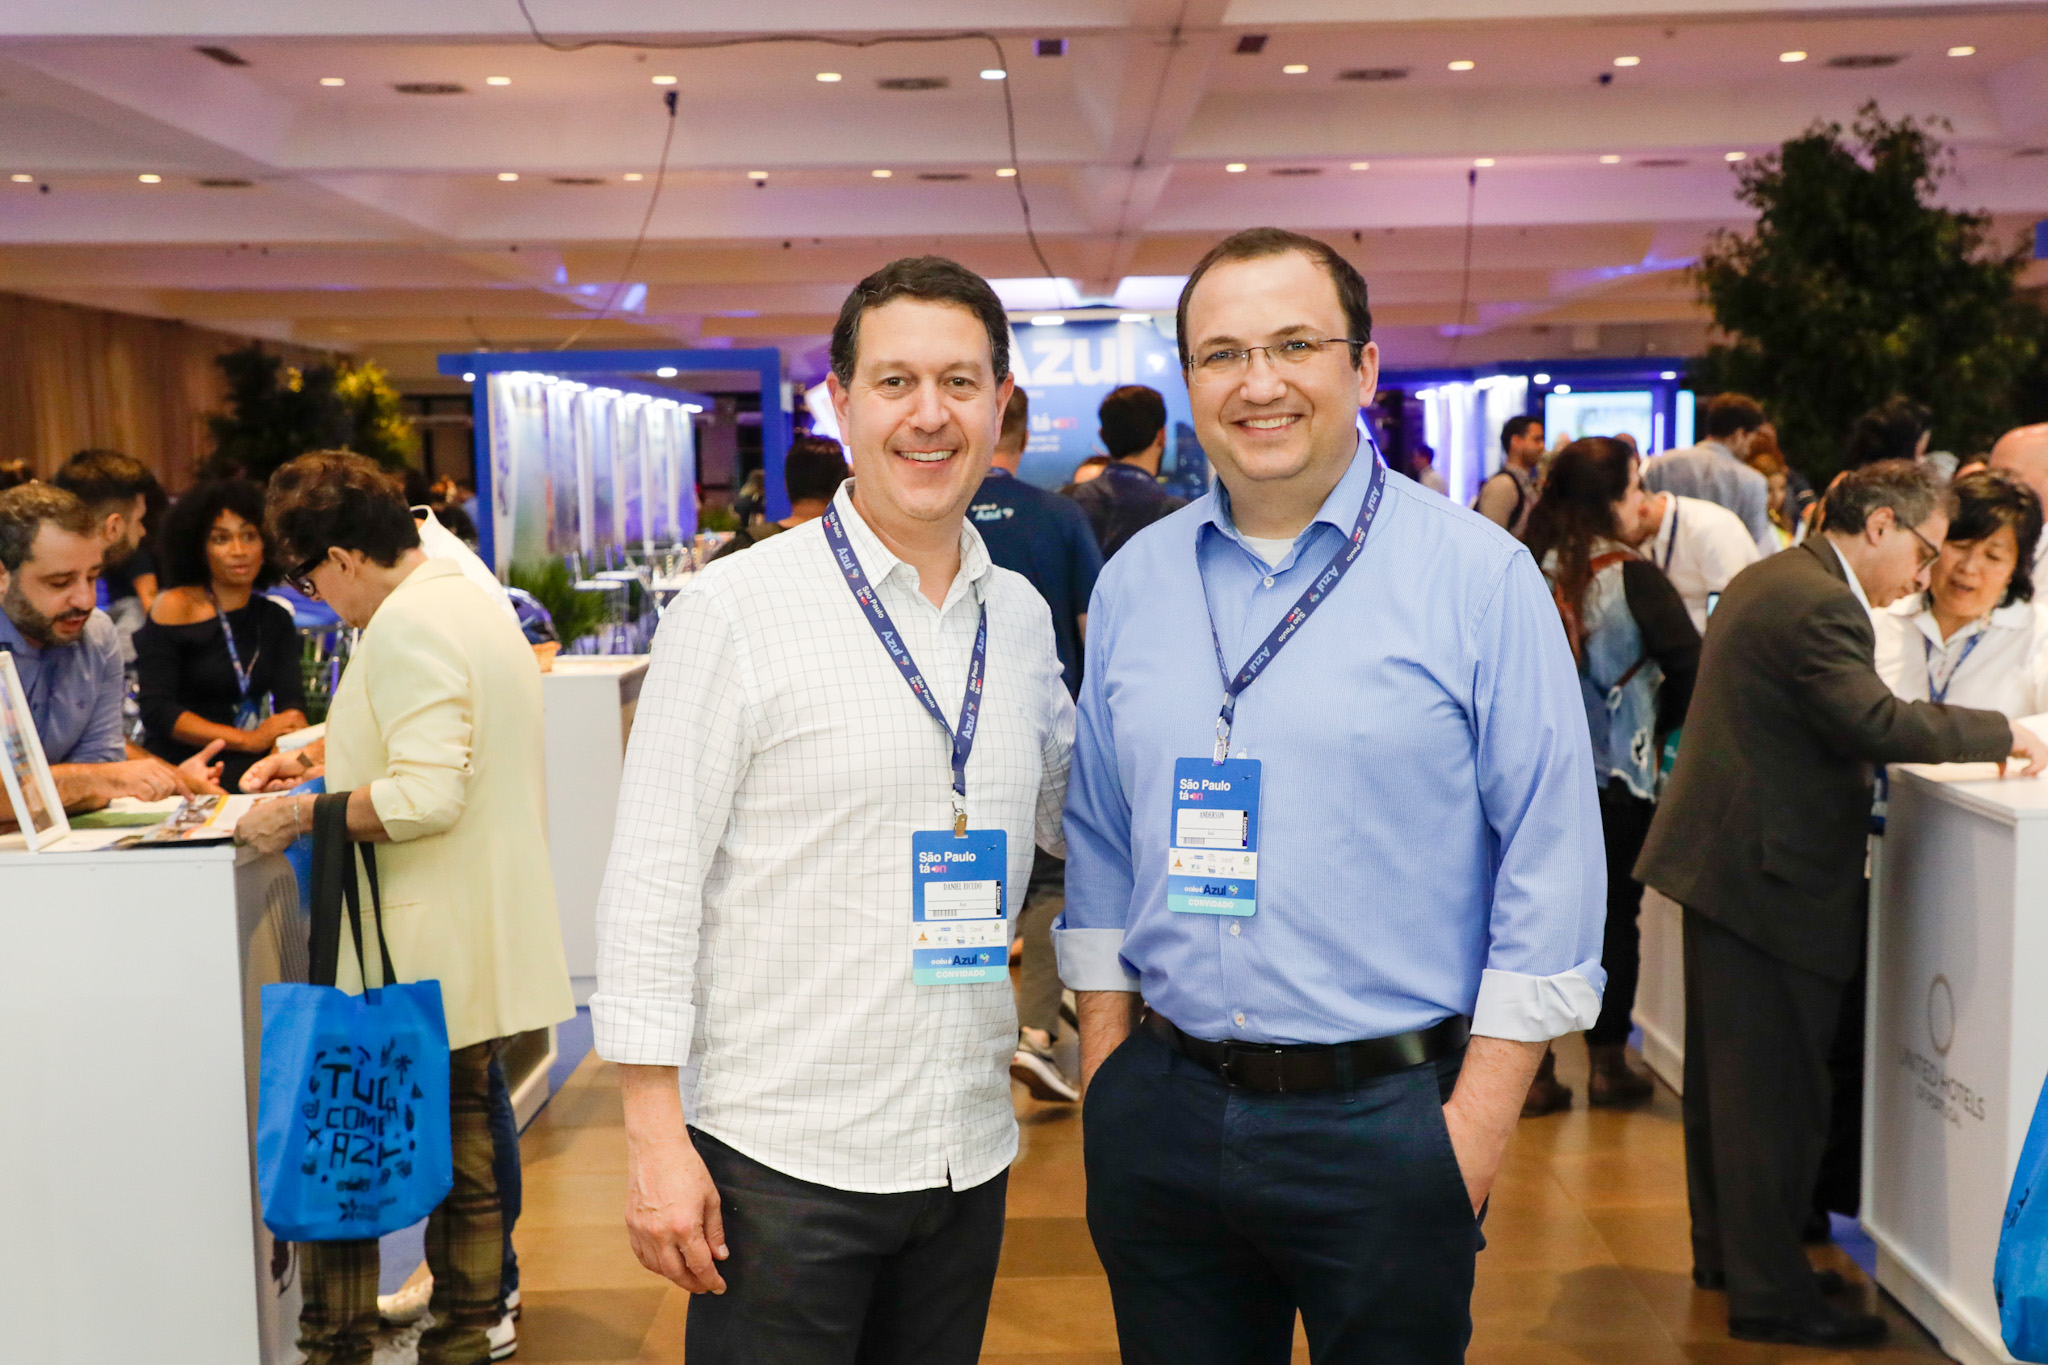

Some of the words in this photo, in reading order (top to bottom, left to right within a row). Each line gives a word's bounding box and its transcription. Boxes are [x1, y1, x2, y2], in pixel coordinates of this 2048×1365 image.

[1367, 486, 1380, 512] Azul
[836, 547, 855, 570] Azul
[1316, 565, 1339, 593] Azul
[869, 598, 884, 619] Paulo
[1278, 623, 1296, 642] Paulo
[881, 631, 904, 656] Azul
[1248, 645, 1271, 674] Azul
[922, 689, 936, 708] Paulo
[961, 712, 975, 740] Azul
[1179, 778, 1200, 790] São
[1201, 779, 1231, 791] Paulo
[919, 851, 942, 863] São
[944, 851, 977, 862] Paulo
[1203, 884, 1226, 896] Azul
[1188, 899, 1235, 908] CONVIDADO
[952, 954, 977, 966] Azul
[935, 970, 986, 978] CONVIDADO
